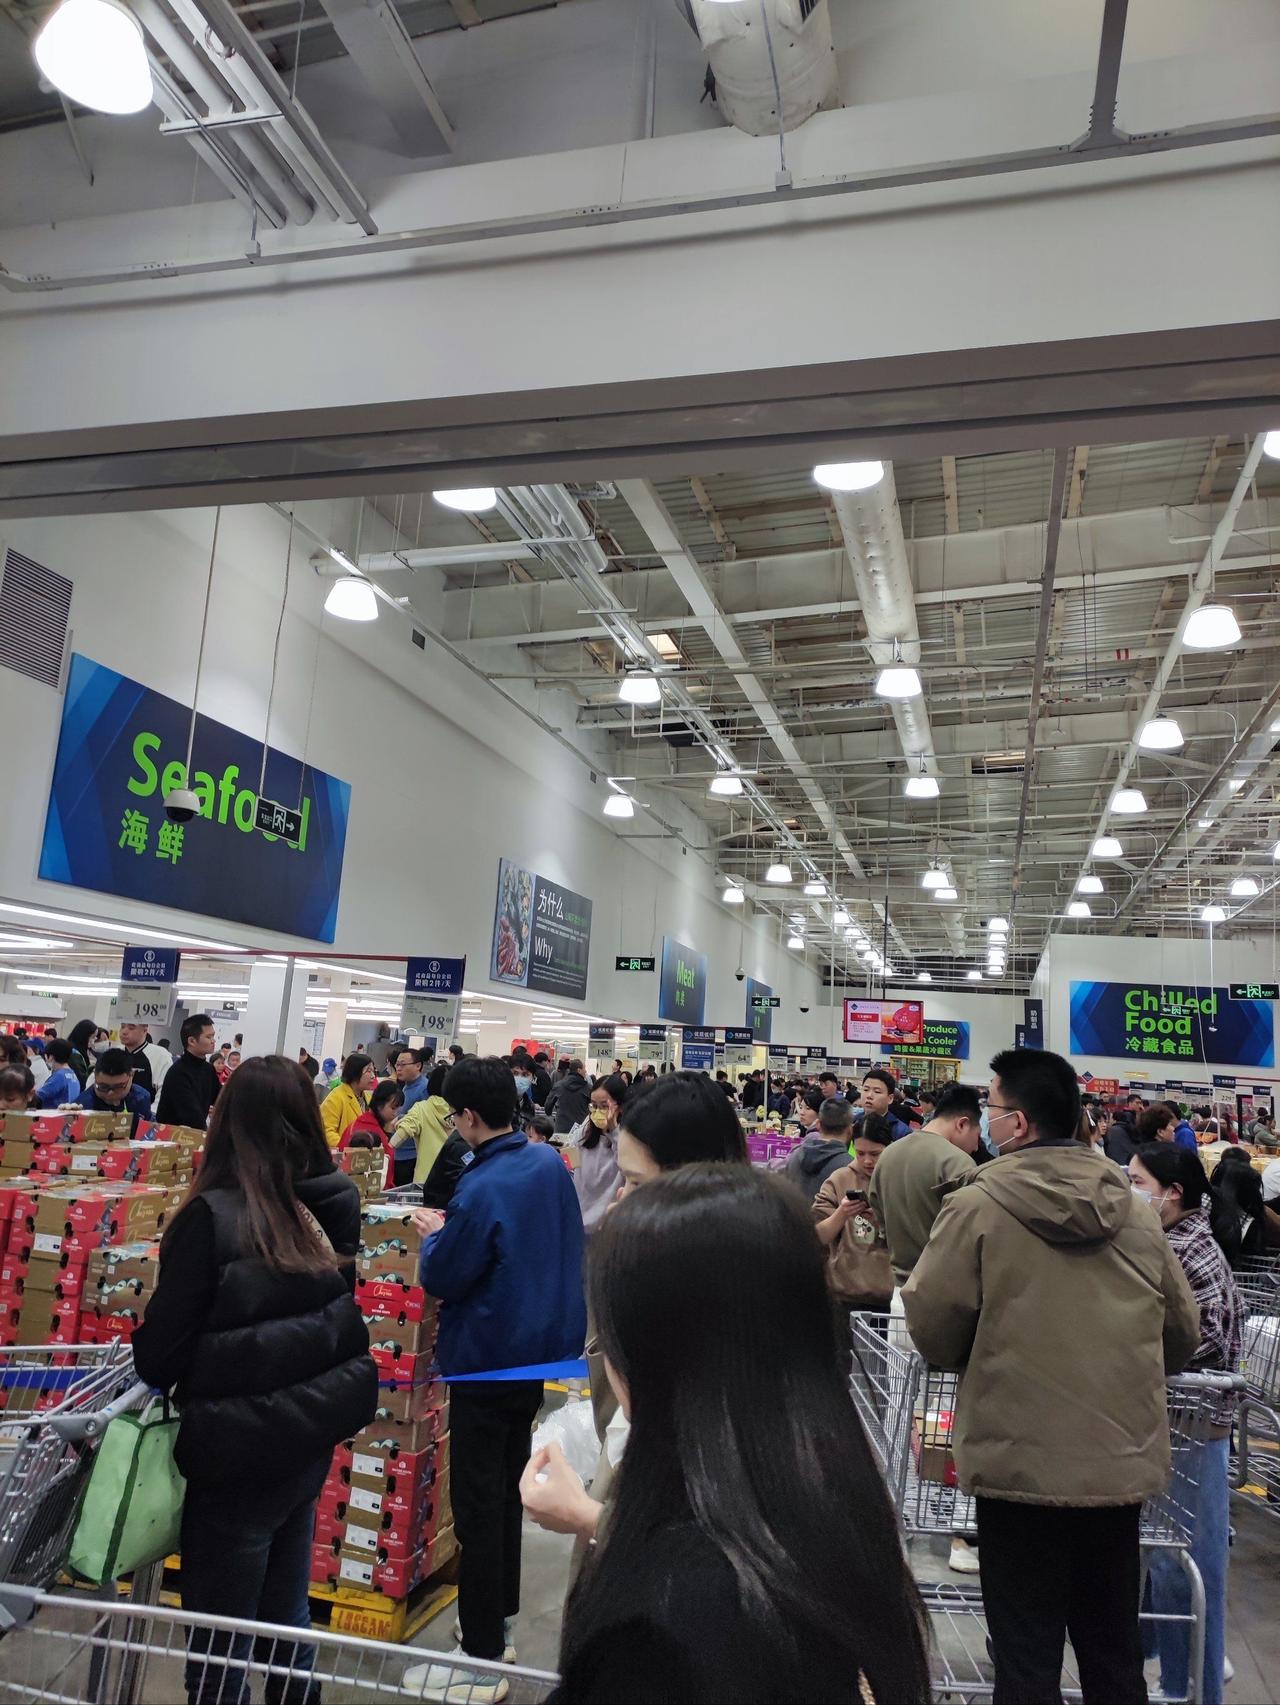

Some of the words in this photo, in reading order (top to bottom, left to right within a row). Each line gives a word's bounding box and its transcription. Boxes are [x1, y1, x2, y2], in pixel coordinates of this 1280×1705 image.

[127, 731, 311, 852] Seafod
[118, 808, 185, 865] 海鲜
[537, 888, 564, 921] 为什么
[534, 935, 553, 965] Why
[676, 959, 695, 990] Meat
[1125, 1011, 1191, 1035] Food
[928, 1036, 958, 1046] Cooler
[1125, 1036, 1194, 1056] 冷藏食品
